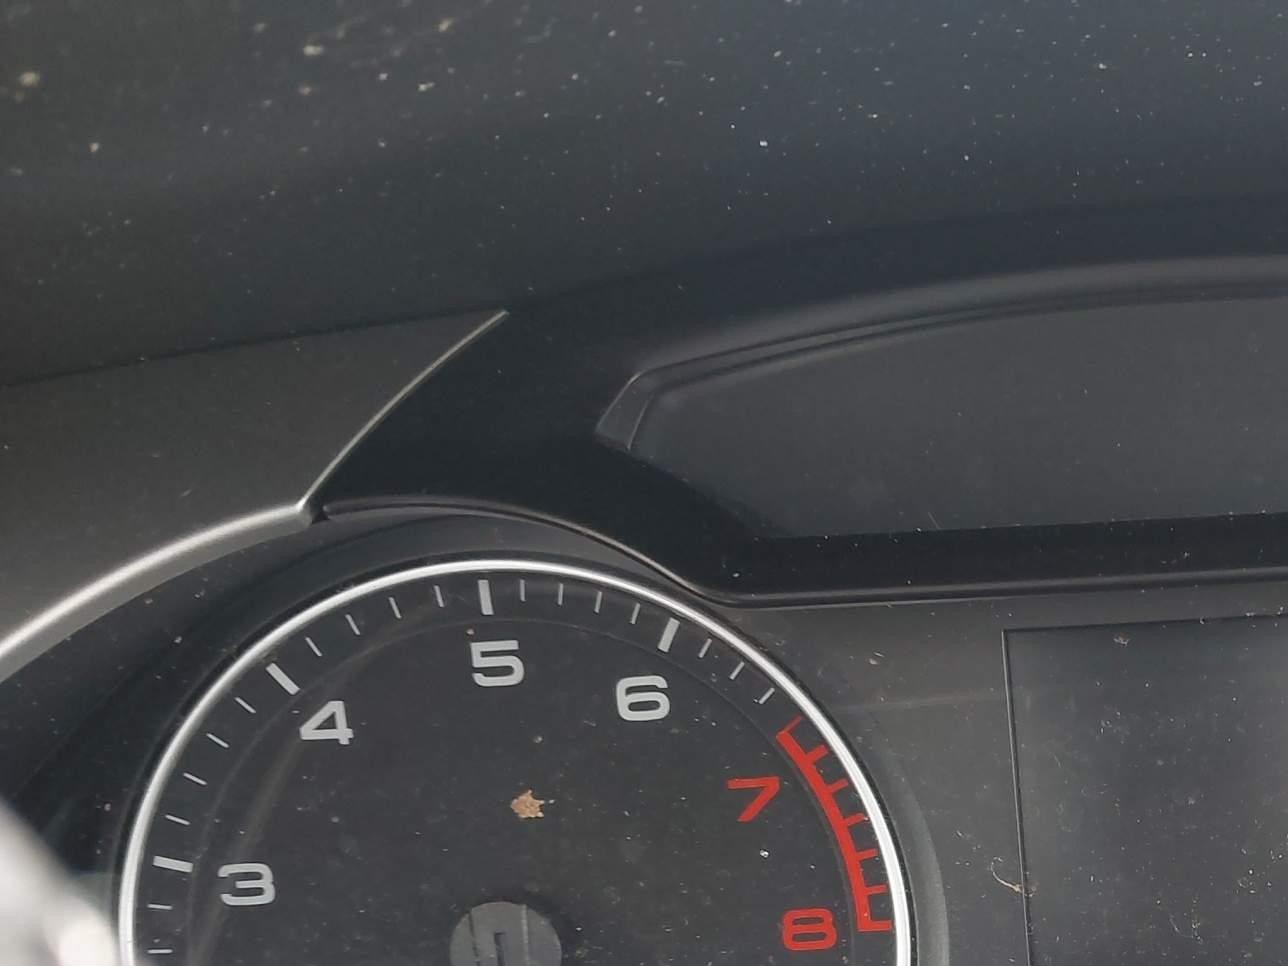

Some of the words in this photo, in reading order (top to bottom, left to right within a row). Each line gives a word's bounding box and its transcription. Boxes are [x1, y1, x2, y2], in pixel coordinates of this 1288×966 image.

[471, 641, 525, 687] 5
[615, 674, 671, 722] 6
[300, 700, 353, 746] 4
[727, 776, 780, 822] 7
[218, 863, 275, 907] 3
[781, 908, 837, 951] 8
